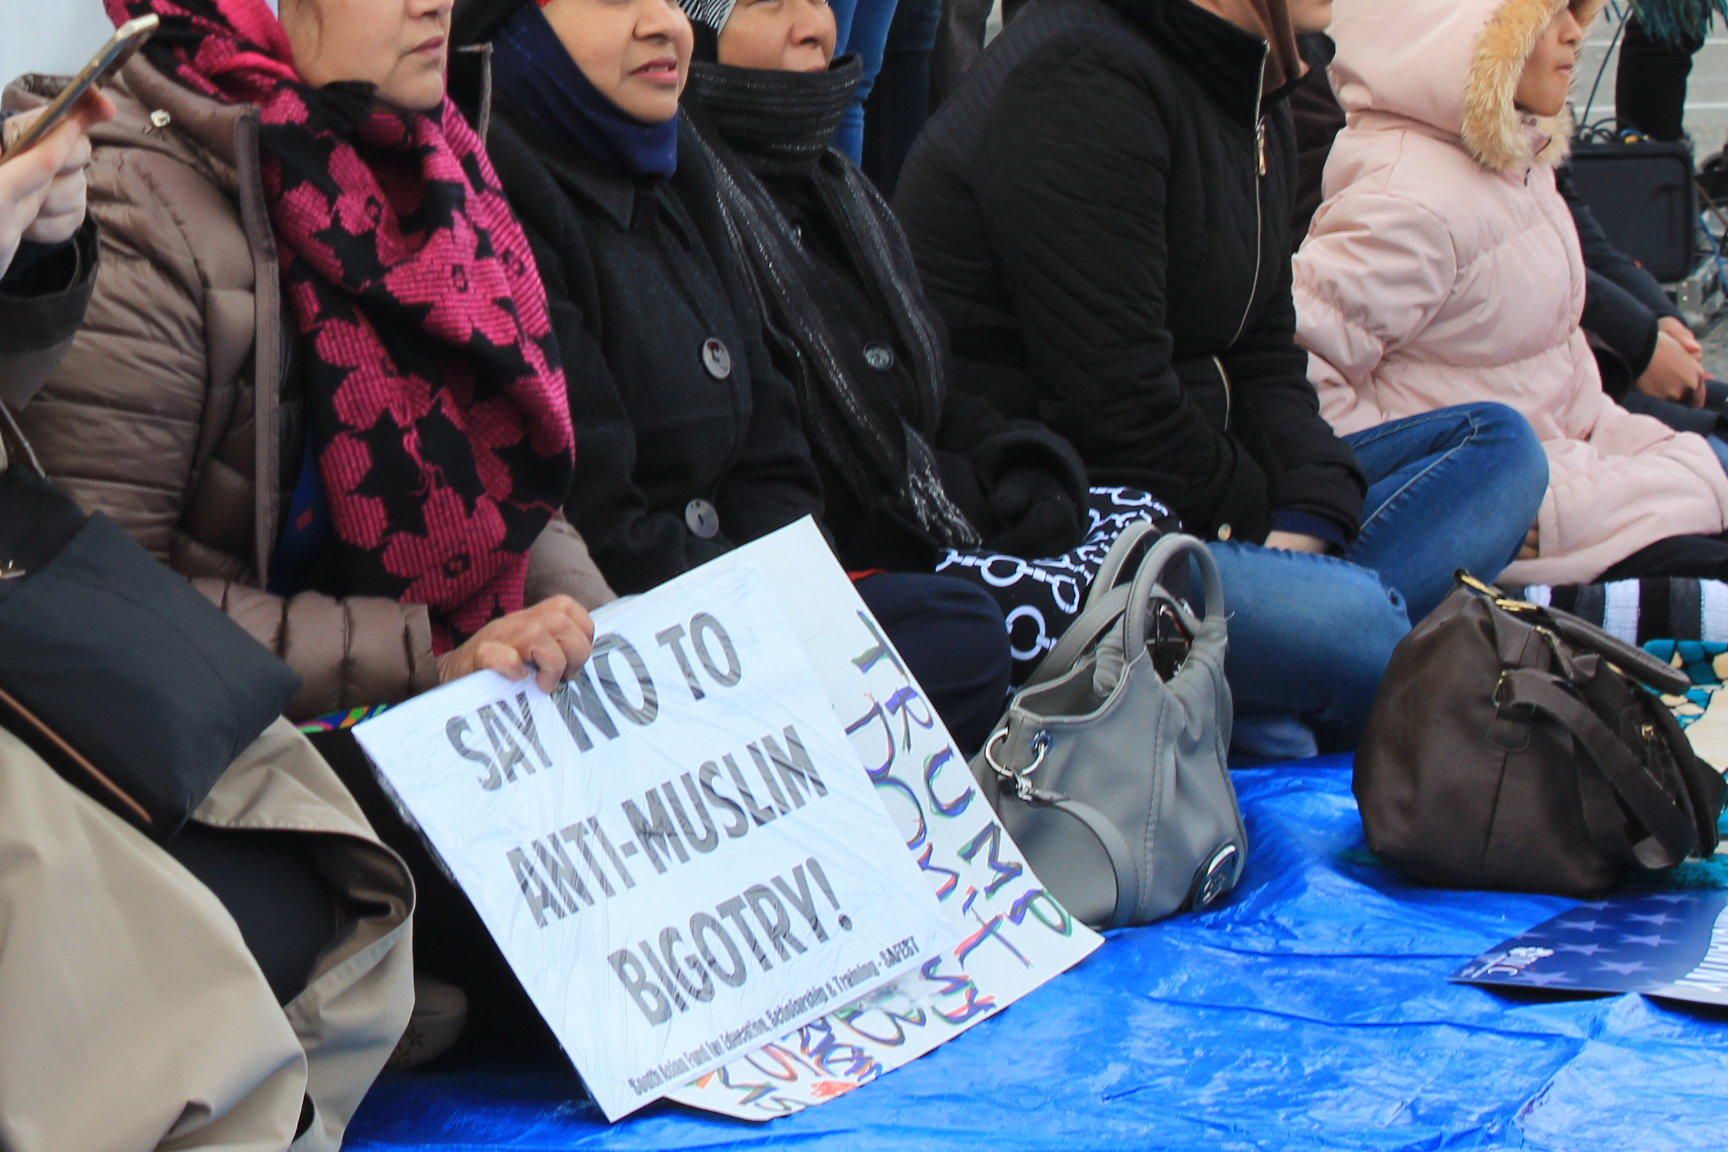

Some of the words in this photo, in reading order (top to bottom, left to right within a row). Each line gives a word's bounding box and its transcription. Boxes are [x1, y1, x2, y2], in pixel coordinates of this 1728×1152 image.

[445, 690, 553, 792] SAY
[550, 632, 660, 754] NO
[655, 612, 743, 702] TO
[851, 609, 1074, 937] TRUMP
[505, 724, 830, 930] ANTI-MUSLIM
[607, 856, 854, 1029] BIGOTRY!
[627, 1068, 665, 1096] South
